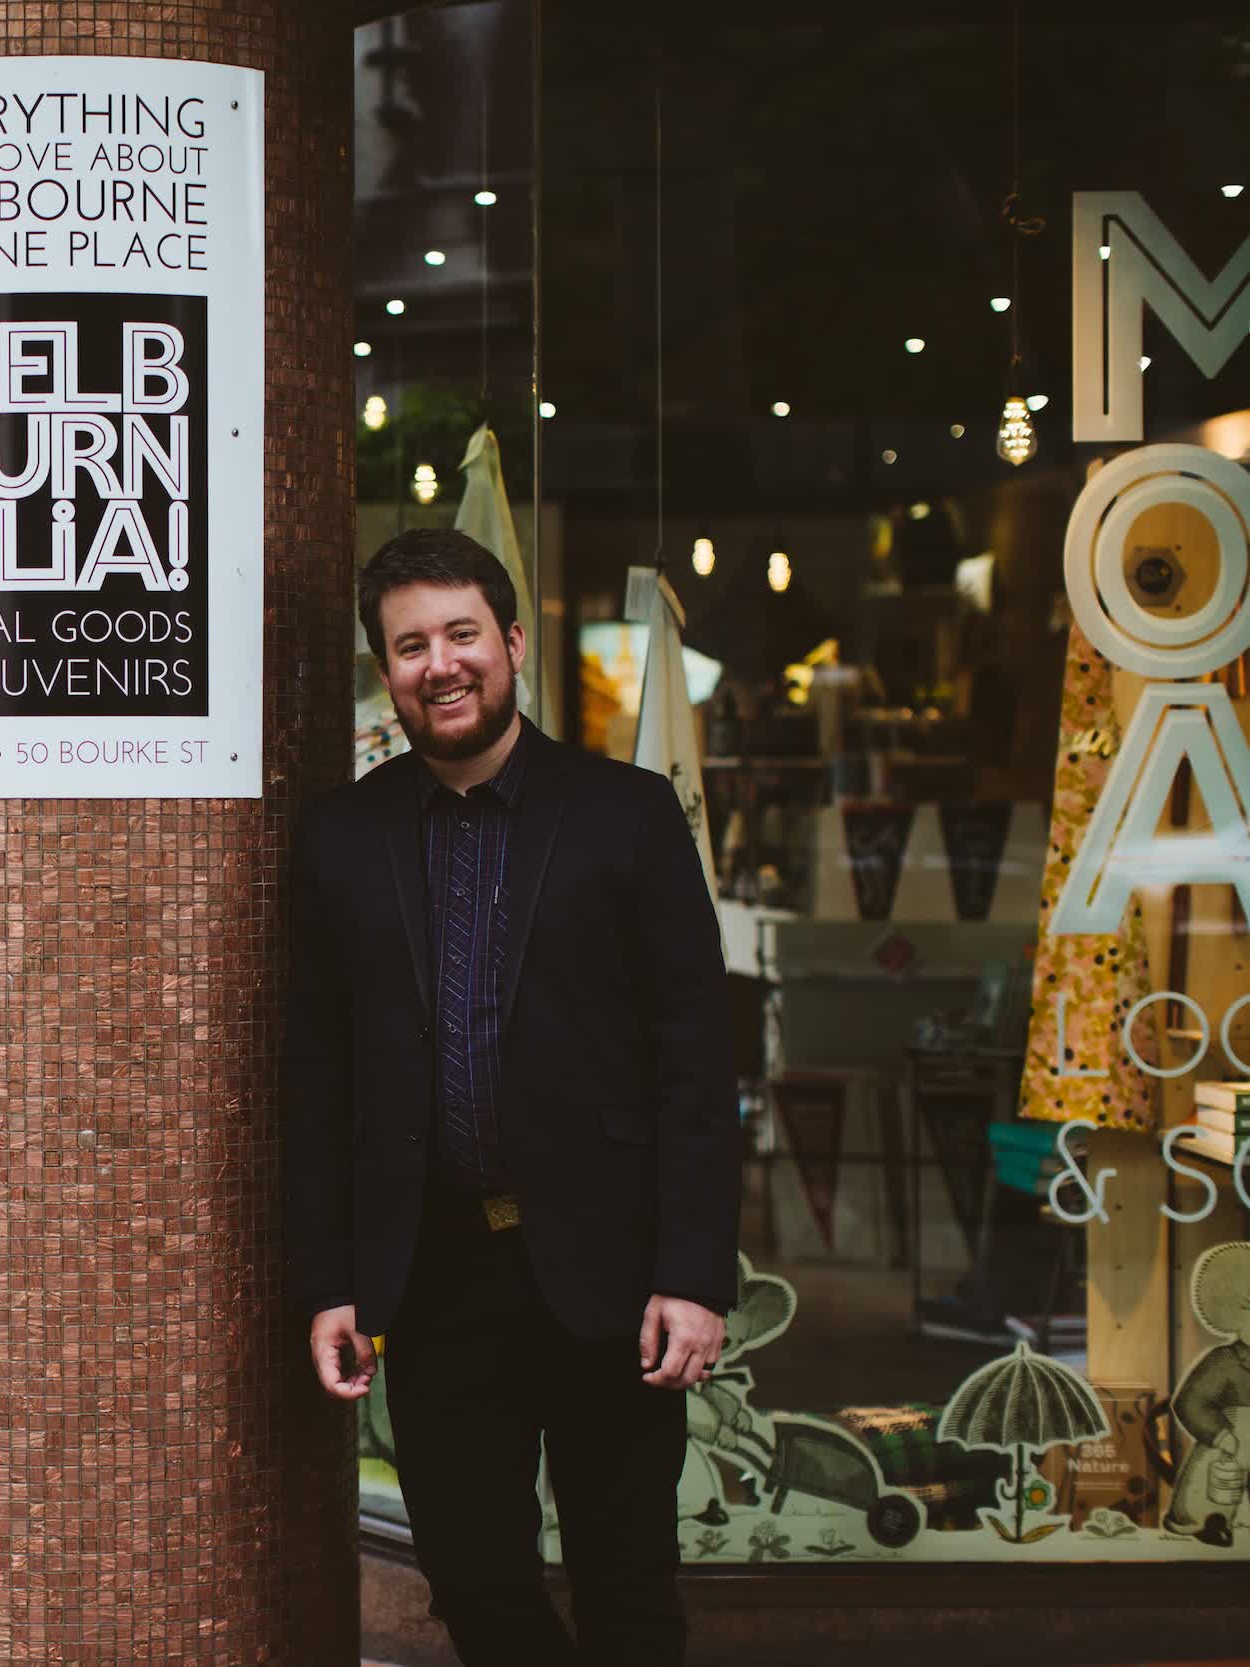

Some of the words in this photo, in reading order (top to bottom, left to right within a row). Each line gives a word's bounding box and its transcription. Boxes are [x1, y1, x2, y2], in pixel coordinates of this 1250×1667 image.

[90, 143, 208, 176] ABOUT
[69, 231, 208, 271] PLACE
[51, 609, 193, 643] GOODS
[16, 741, 49, 764] 50
[60, 740, 168, 764] BOURKE
[180, 740, 210, 764] ST
[1050, 1119, 1118, 1225] &
[1159, 1125, 1250, 1223] S
[1068, 1457, 1130, 1473] Nature
